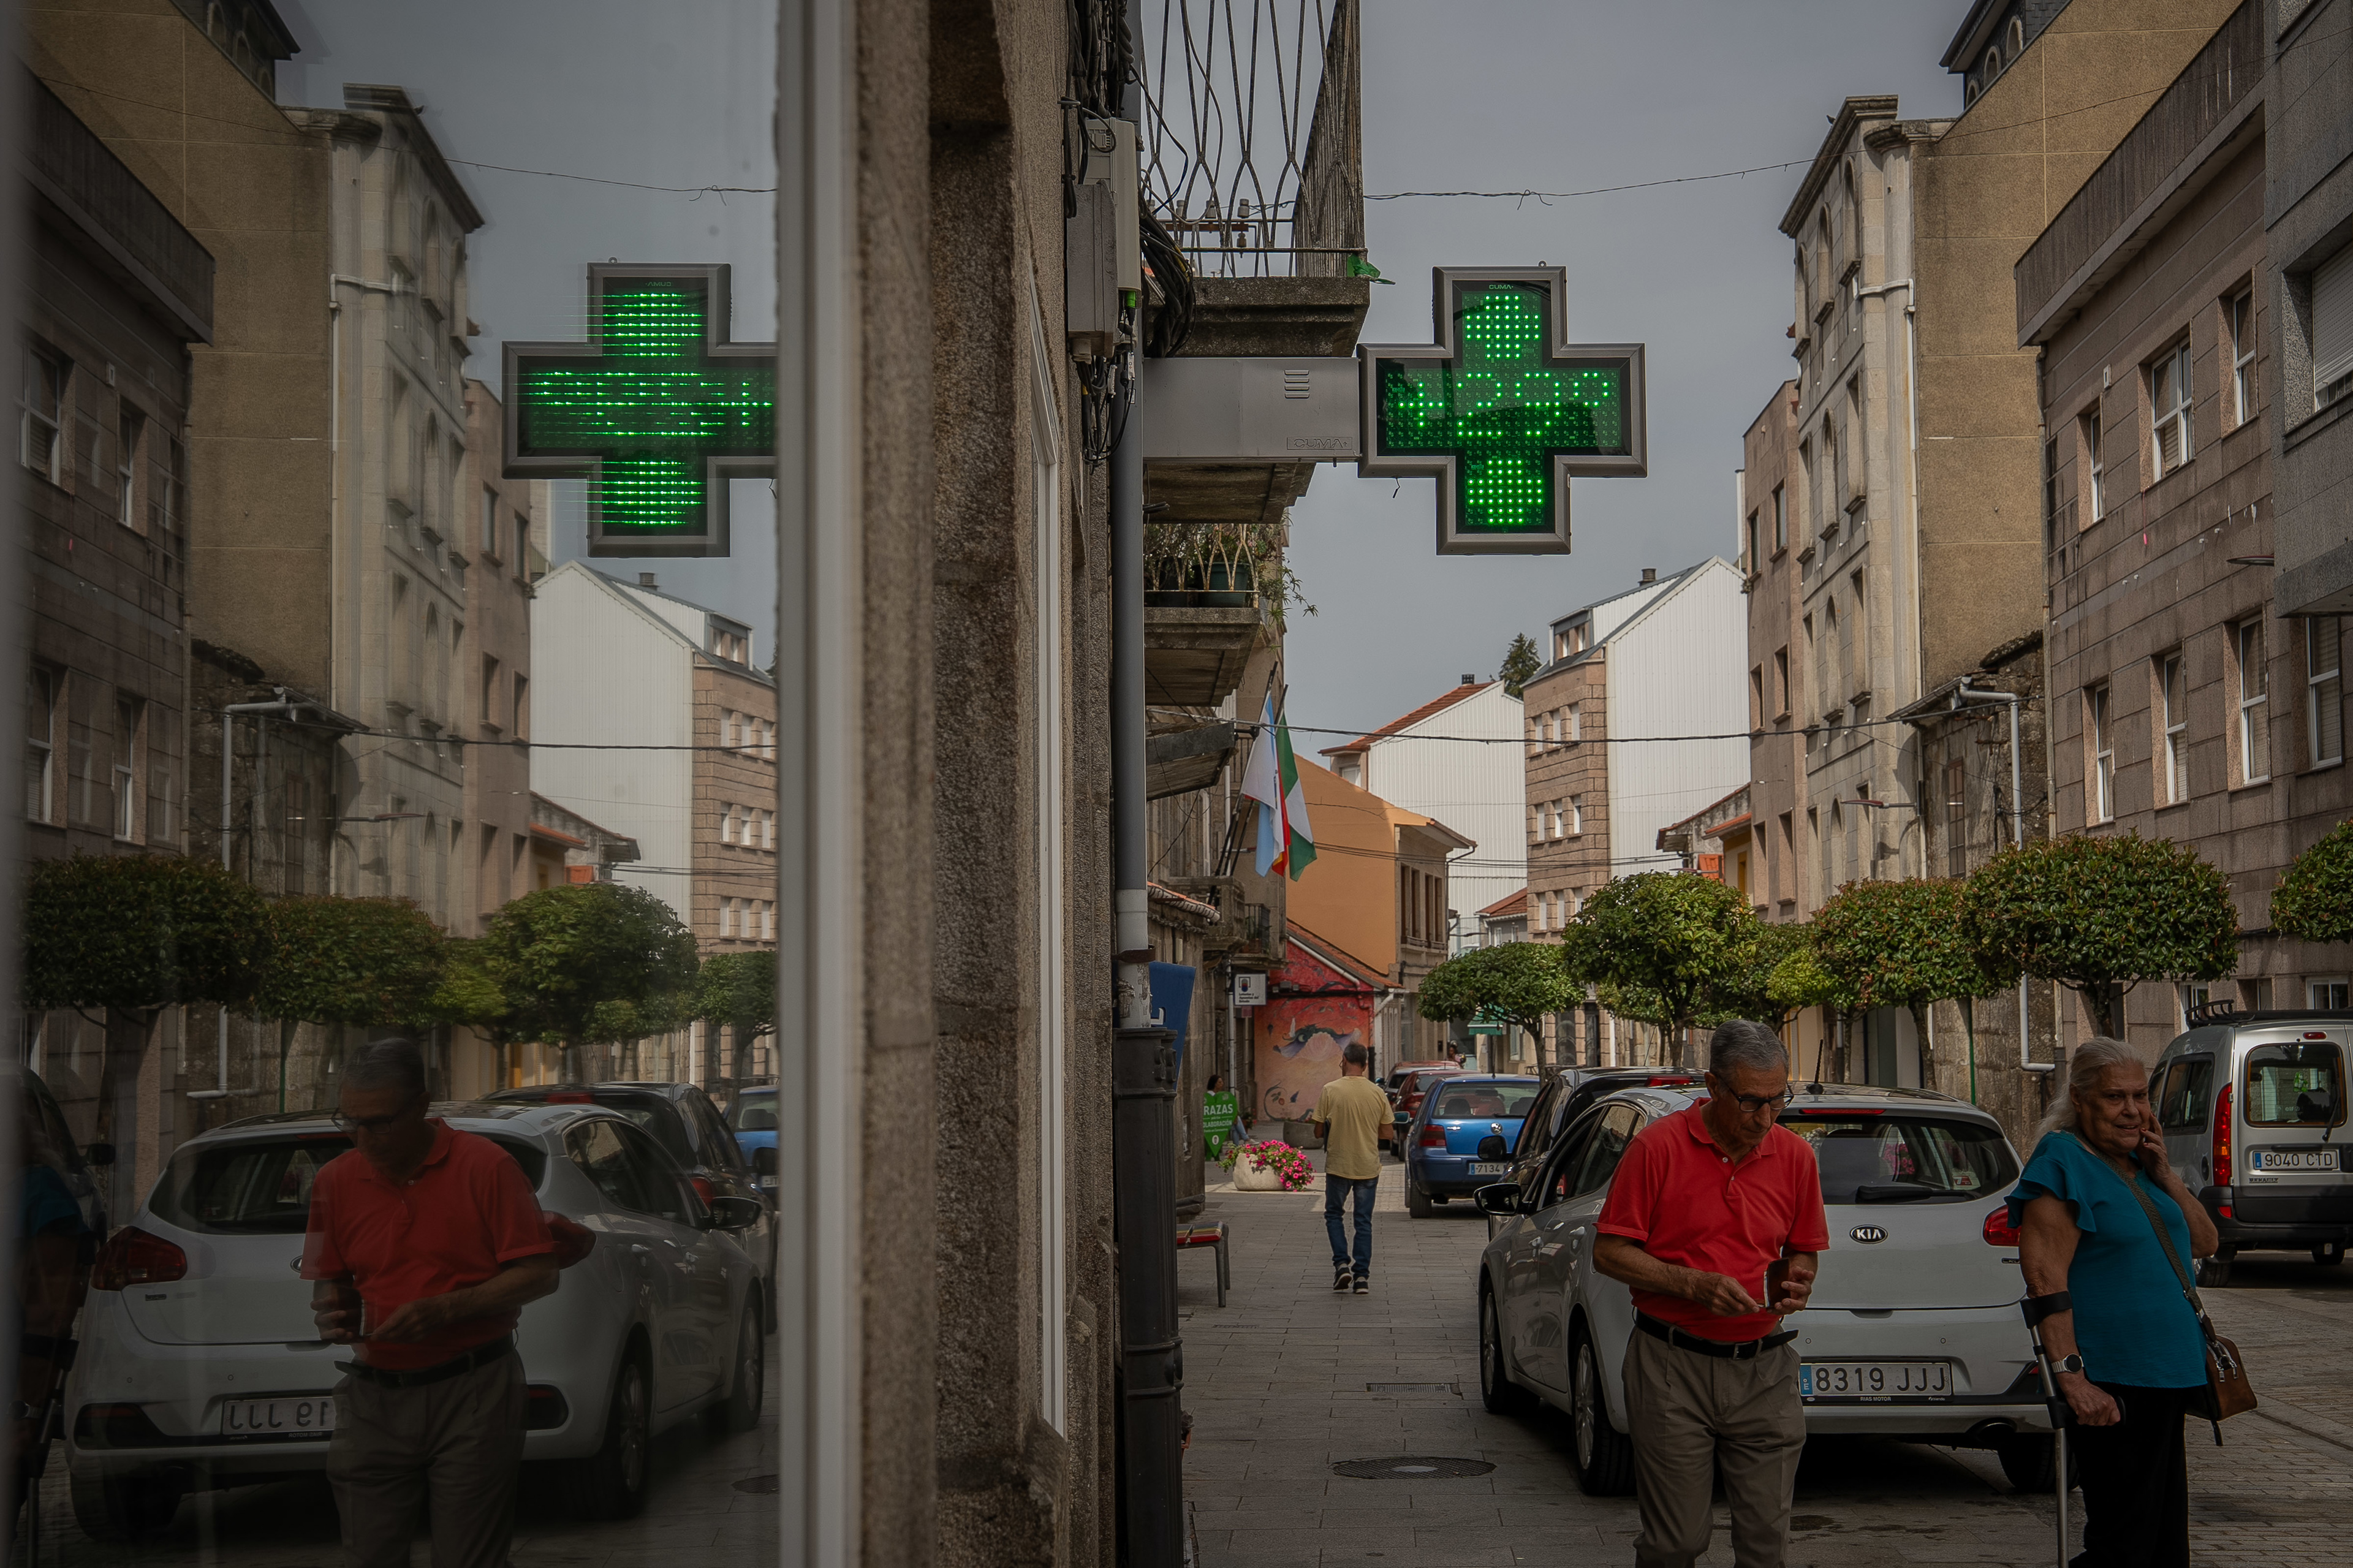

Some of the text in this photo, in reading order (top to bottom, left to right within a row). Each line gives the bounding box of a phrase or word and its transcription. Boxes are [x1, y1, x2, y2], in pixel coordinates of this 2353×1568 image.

[2264, 1153, 2300, 1167] 9040
[2306, 1153, 2333, 1167] CTD
[1477, 1164, 1501, 1173] 7134
[1856, 1229, 1882, 1240] KIA
[1816, 1367, 1885, 1392] 8319
[1896, 1367, 1946, 1392] JJJ
